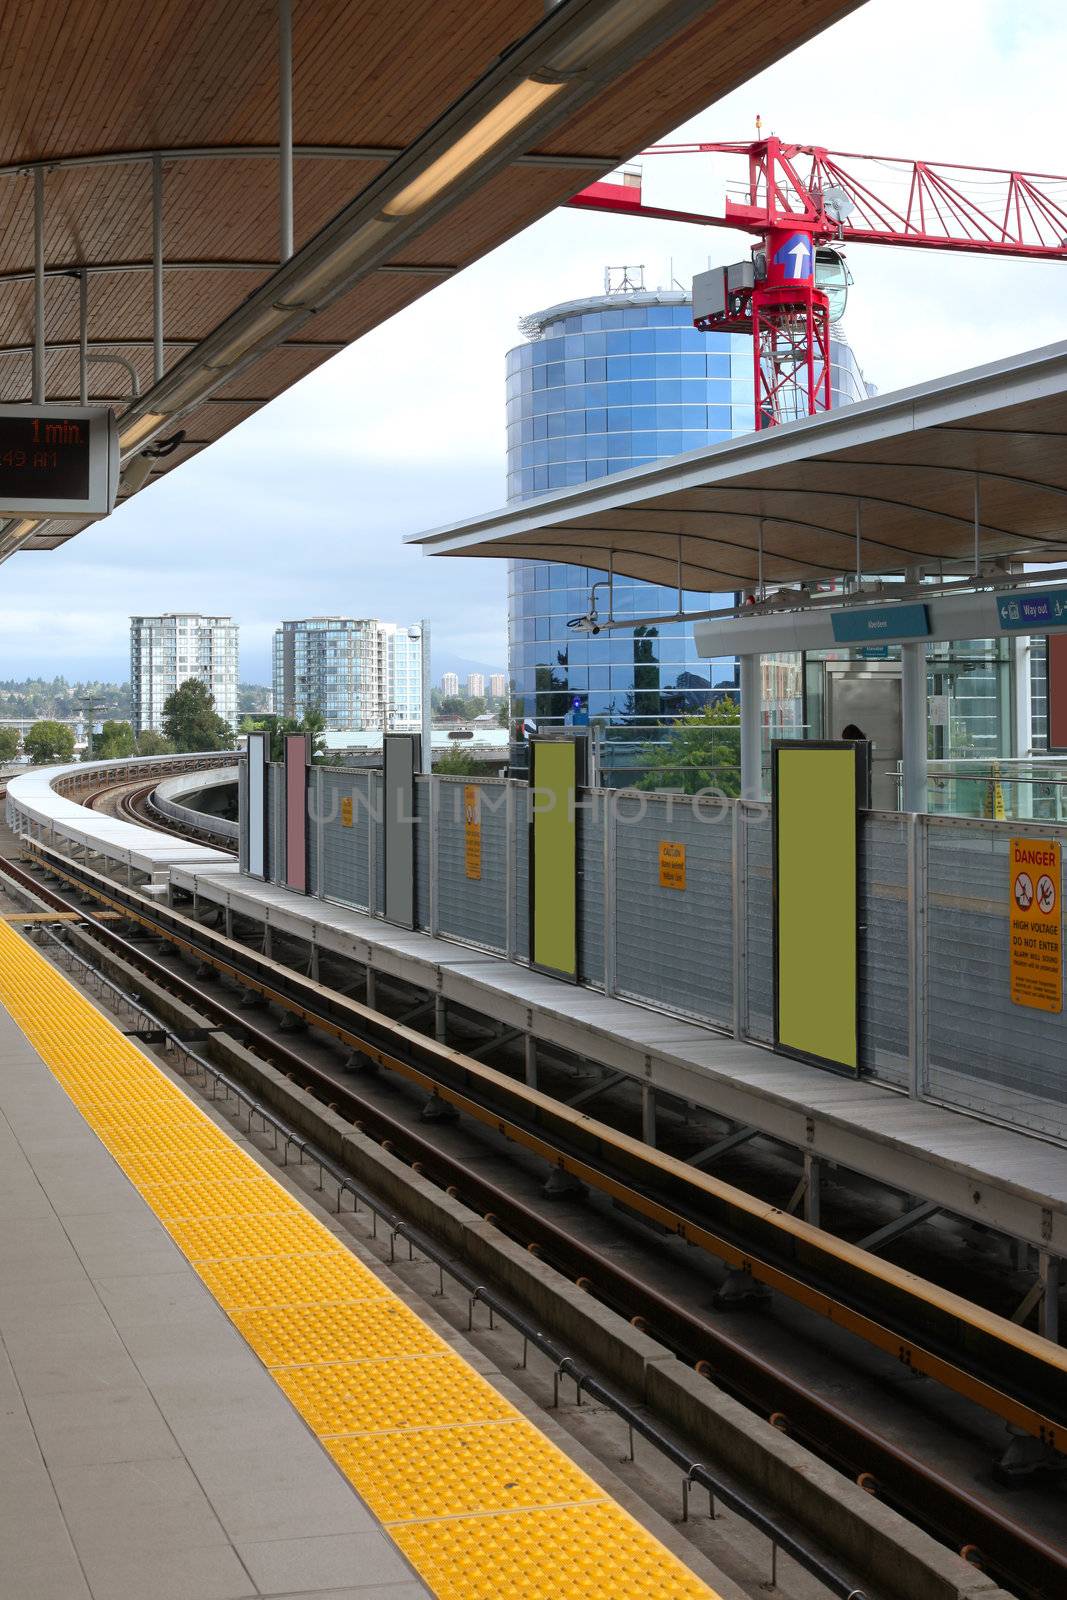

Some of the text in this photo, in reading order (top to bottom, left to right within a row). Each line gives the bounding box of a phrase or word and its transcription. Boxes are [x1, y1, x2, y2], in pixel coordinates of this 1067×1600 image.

[32, 418, 41, 443] 1
[1023, 602, 1048, 617] Way out
[1014, 848, 1056, 867] DANGER
[1013, 920, 1058, 935] HIGH VOLTAGE
[1013, 936, 1058, 952] DO NOT ENTER
